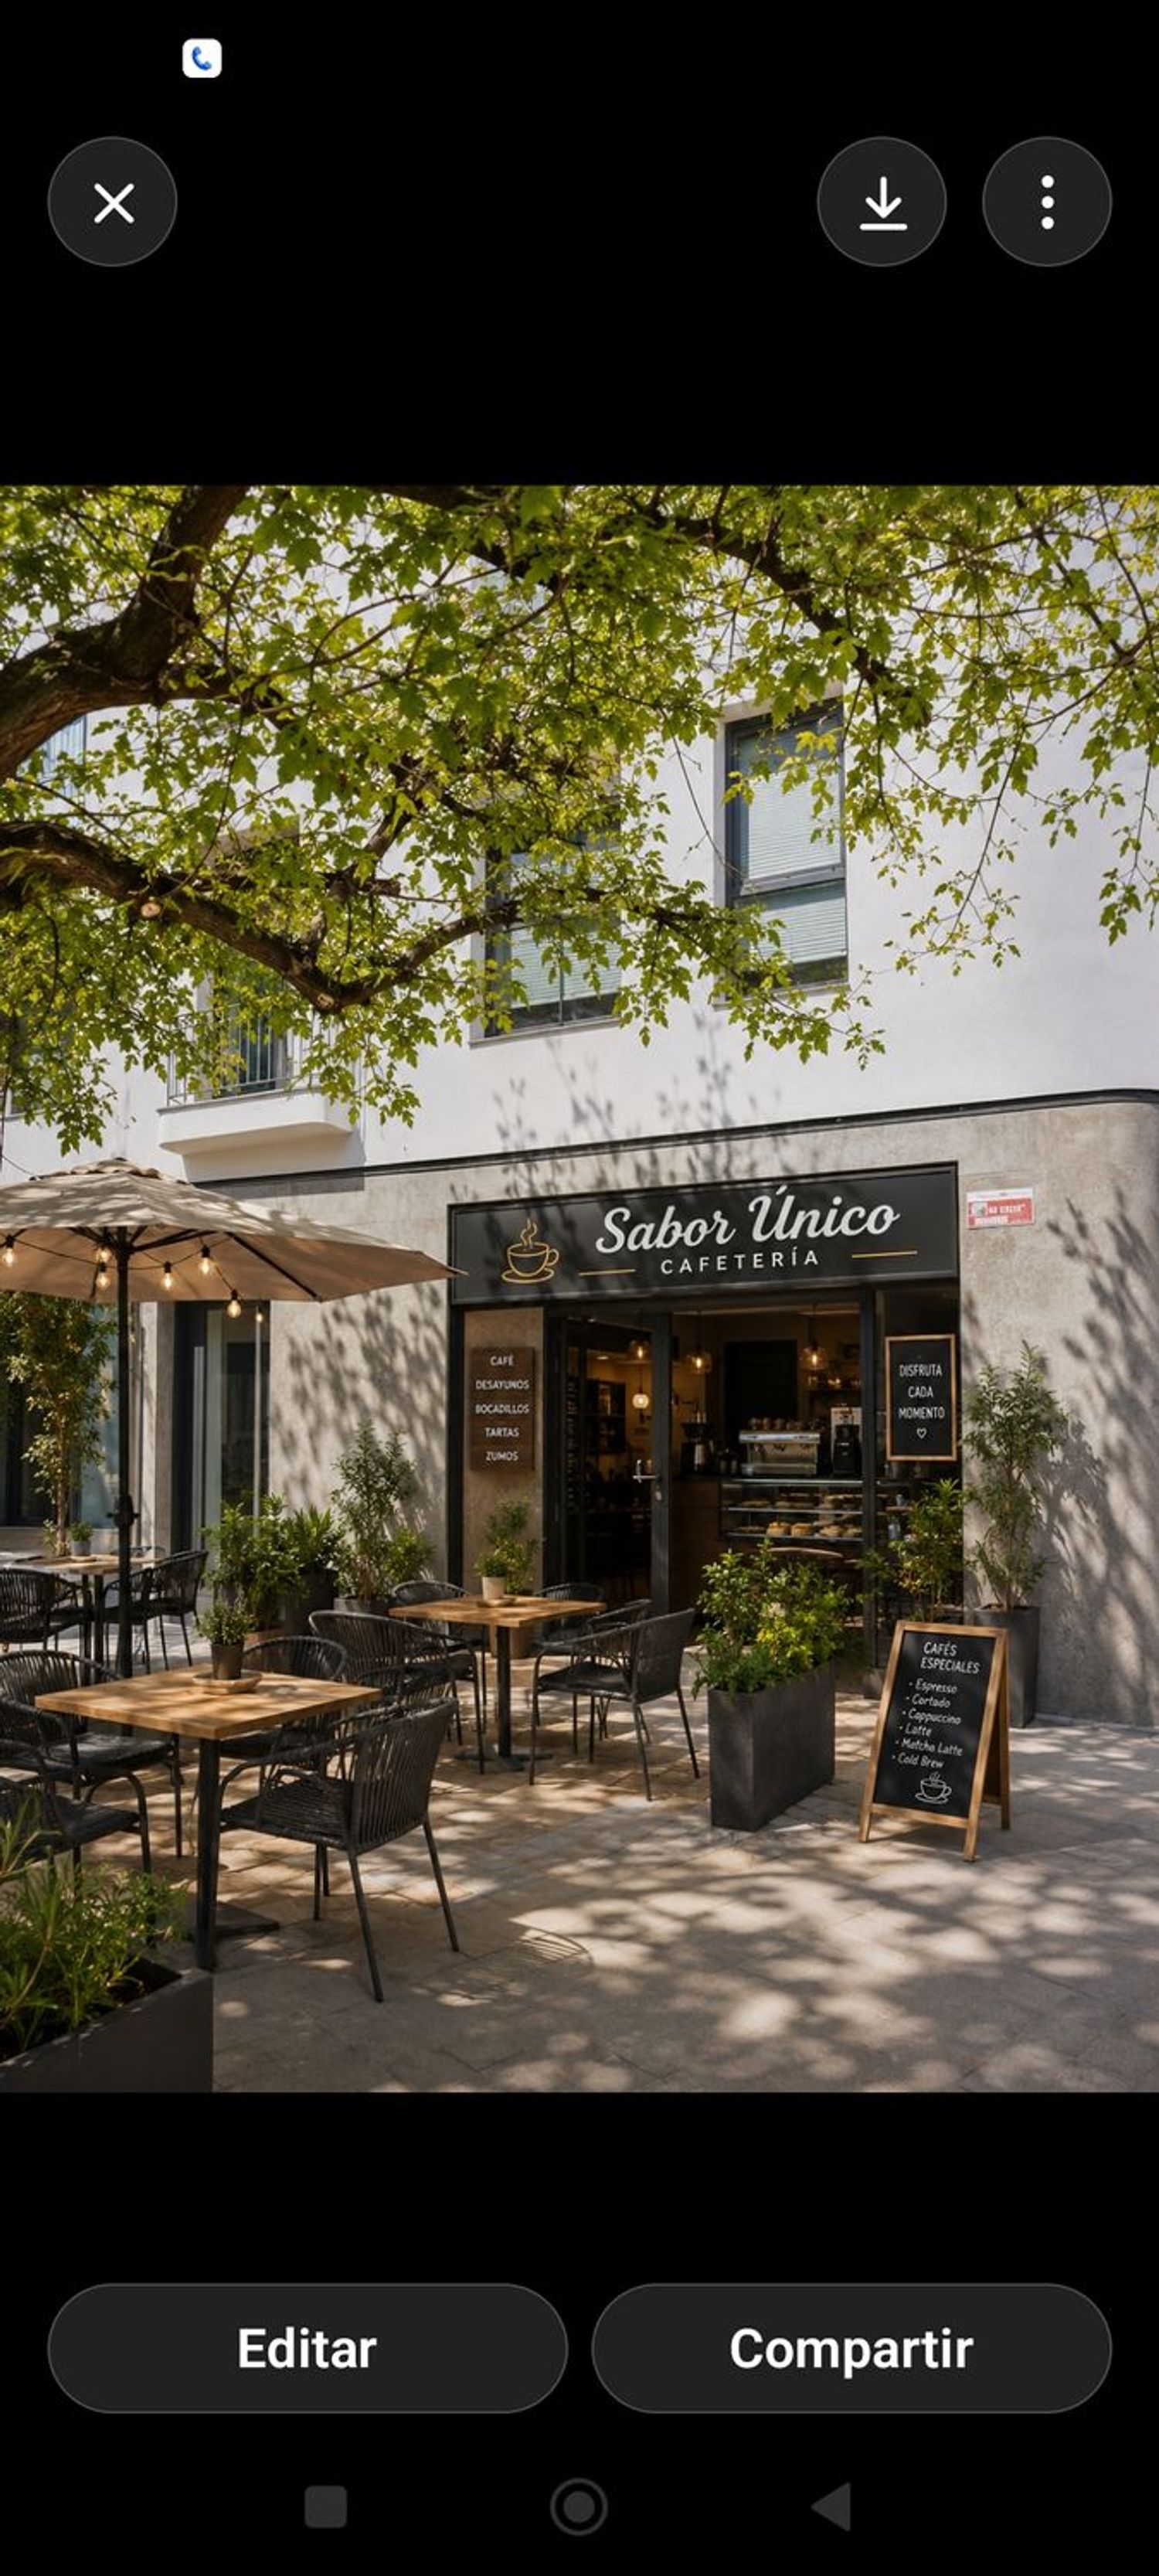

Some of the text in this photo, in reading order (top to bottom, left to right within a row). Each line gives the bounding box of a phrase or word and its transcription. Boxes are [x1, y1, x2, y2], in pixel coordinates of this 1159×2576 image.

[595, 1185, 900, 1254] Sabor Único
[661, 1246, 819, 1275] CAFETERÍA
[490, 1354, 514, 1366] CAFÉ
[899, 1364, 942, 1376] DISFRUTA
[475, 1379, 530, 1390] DESAYUNOS
[909, 1386, 933, 1397] CADA
[475, 1403, 530, 1414] BOCADILLOS
[899, 1407, 944, 1419] MOMENTO
[484, 1427, 519, 1438] TARTAS
[485, 1451, 518, 1462] ZUMOS
[924, 1641, 957, 1656] CAFÉS
[921, 1657, 981, 1673] ESPECIALES
[916, 1678, 957, 1693] Espresso
[912, 1694, 950, 1707] Cortado
[909, 1708, 961, 1724] Cappuccino
[906, 1723, 931, 1736] Latte
[938, 1743, 962, 1756] Latte
[898, 1752, 944, 1768] Cold Brew
